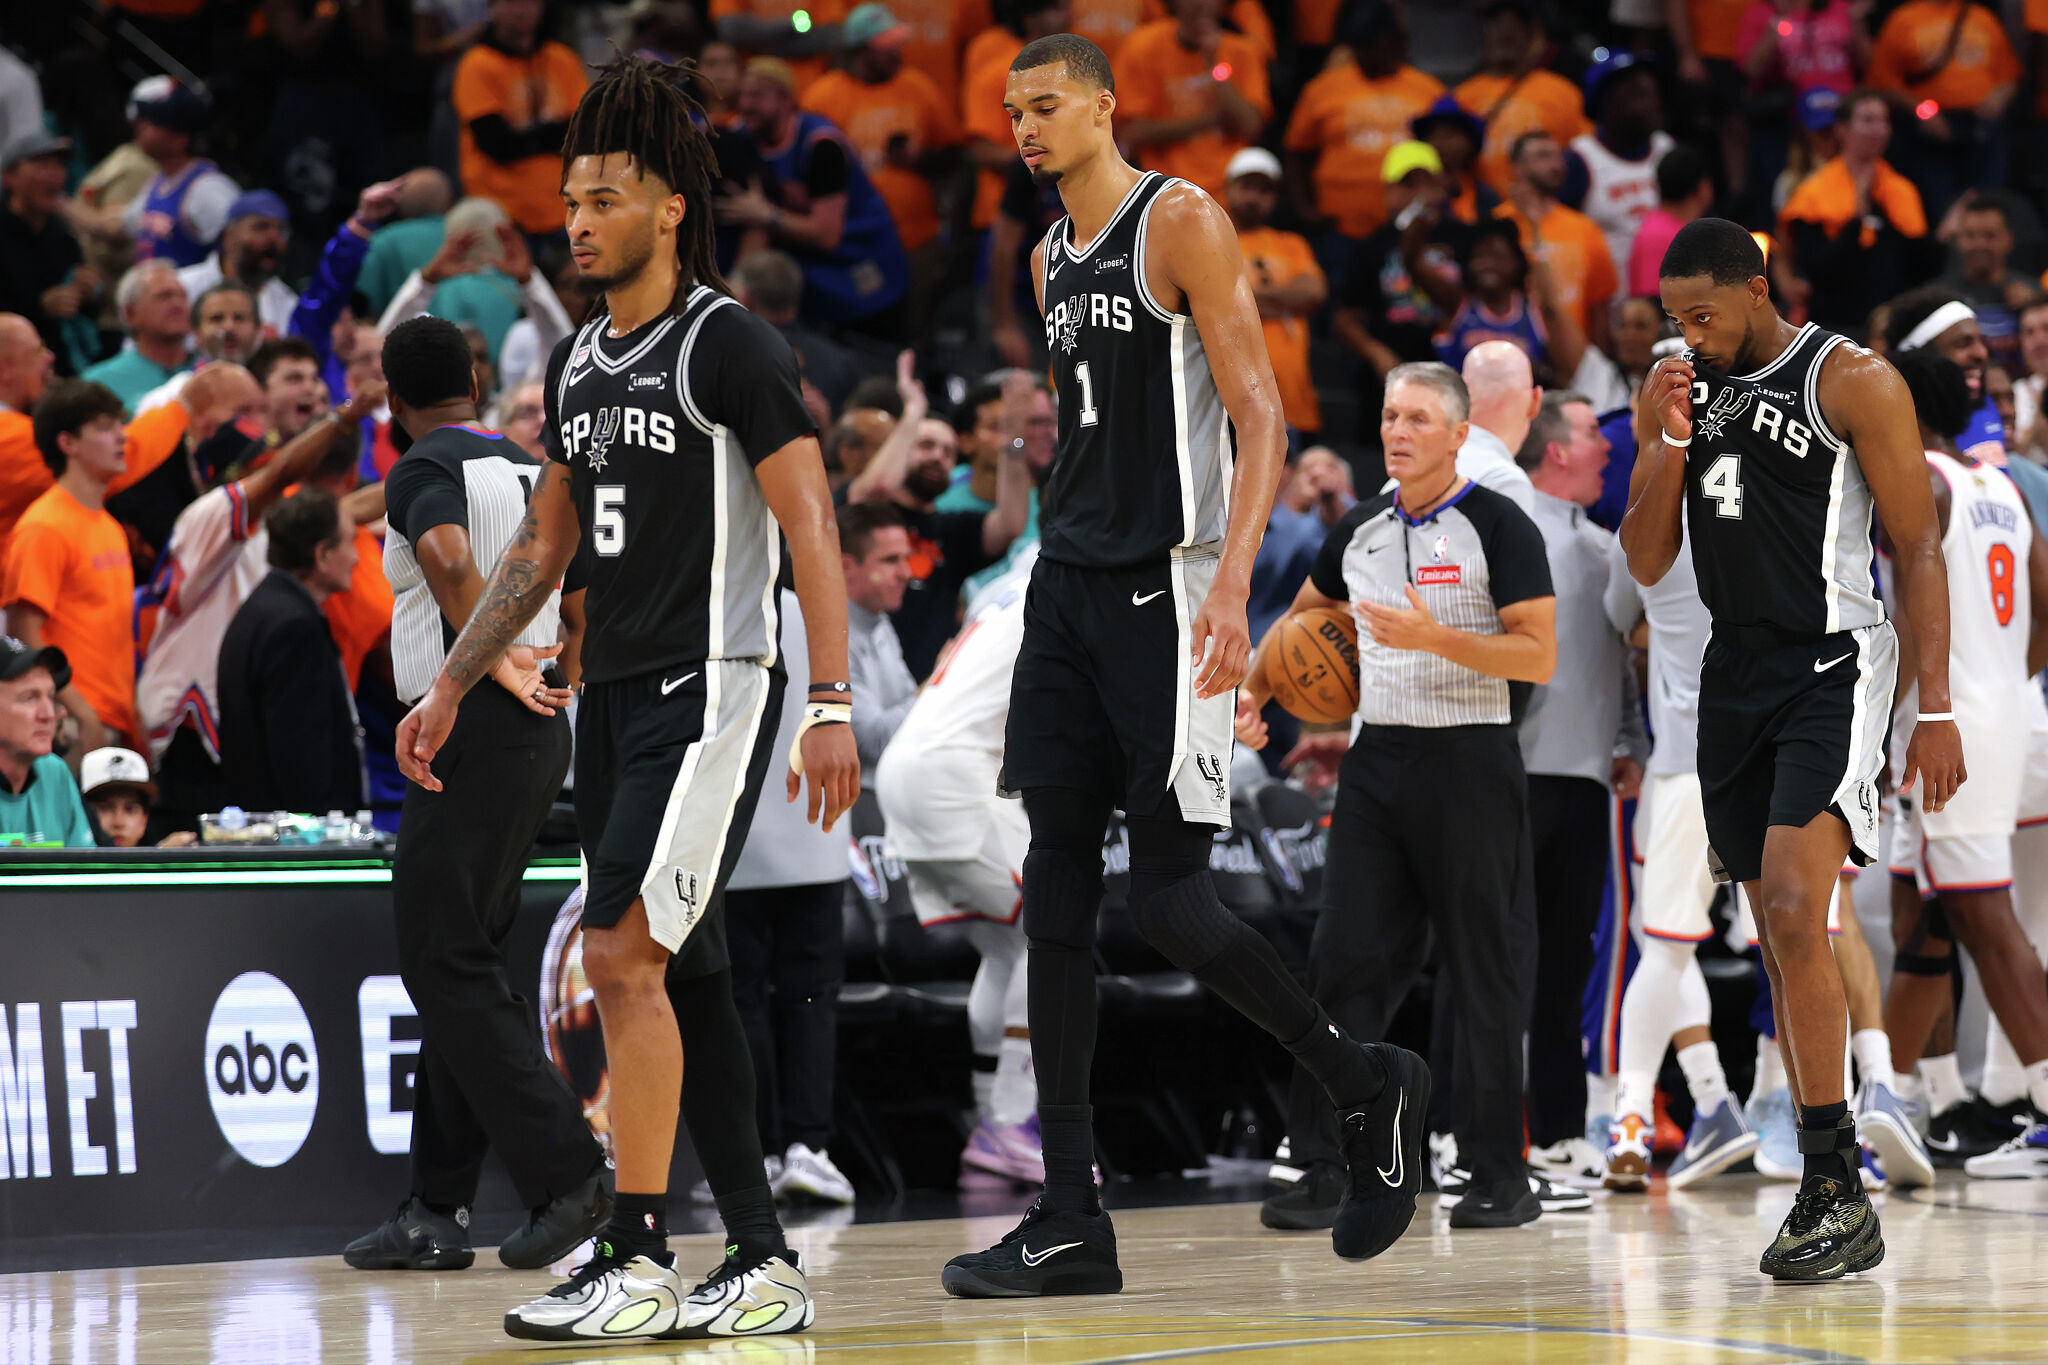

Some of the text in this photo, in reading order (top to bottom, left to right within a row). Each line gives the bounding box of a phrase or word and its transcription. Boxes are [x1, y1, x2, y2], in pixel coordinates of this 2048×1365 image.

[1098, 257, 1125, 270] LEDGER
[632, 376, 662, 387] LEDGER
[1074, 360, 1099, 428] 1
[1757, 387, 1791, 401] LEDGER
[1700, 453, 1745, 521] 4
[593, 485, 626, 557] 5
[1986, 543, 2015, 627] 8
[215, 1029, 310, 1096] abc
